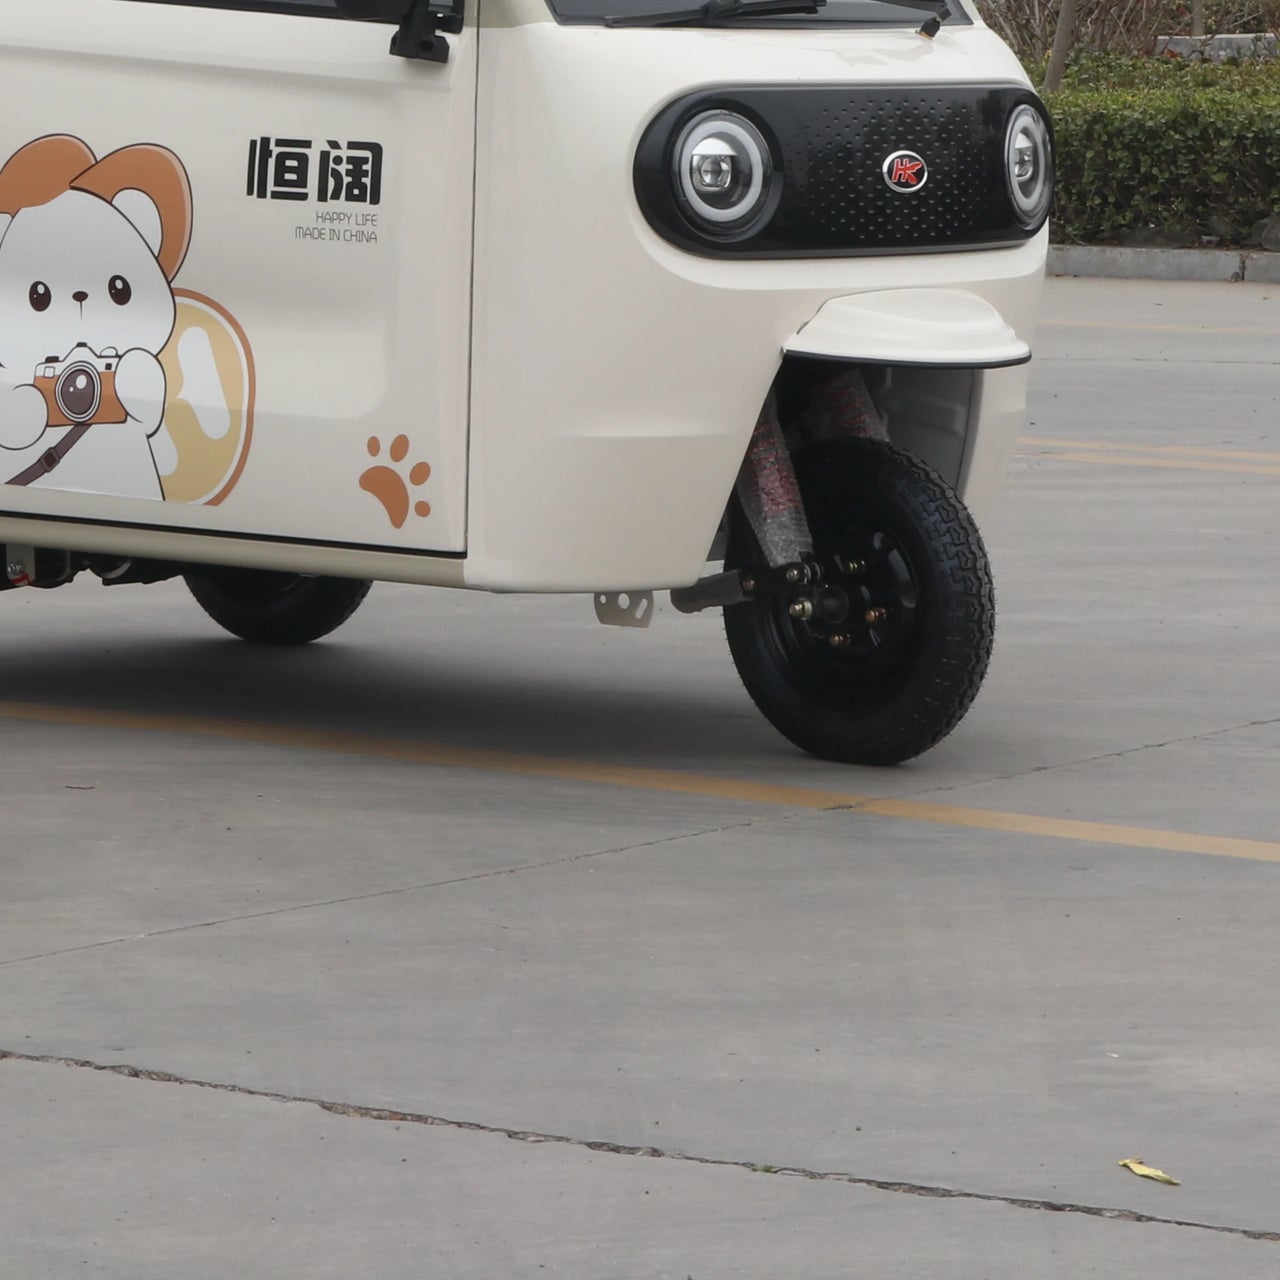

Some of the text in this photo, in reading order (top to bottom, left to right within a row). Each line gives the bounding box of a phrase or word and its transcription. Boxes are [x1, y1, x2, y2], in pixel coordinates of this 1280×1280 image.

[246, 136, 383, 206] 恒阔
[315, 211, 378, 227] HAPPY LIFE
[295, 226, 378, 243] MADE IN CHINA
